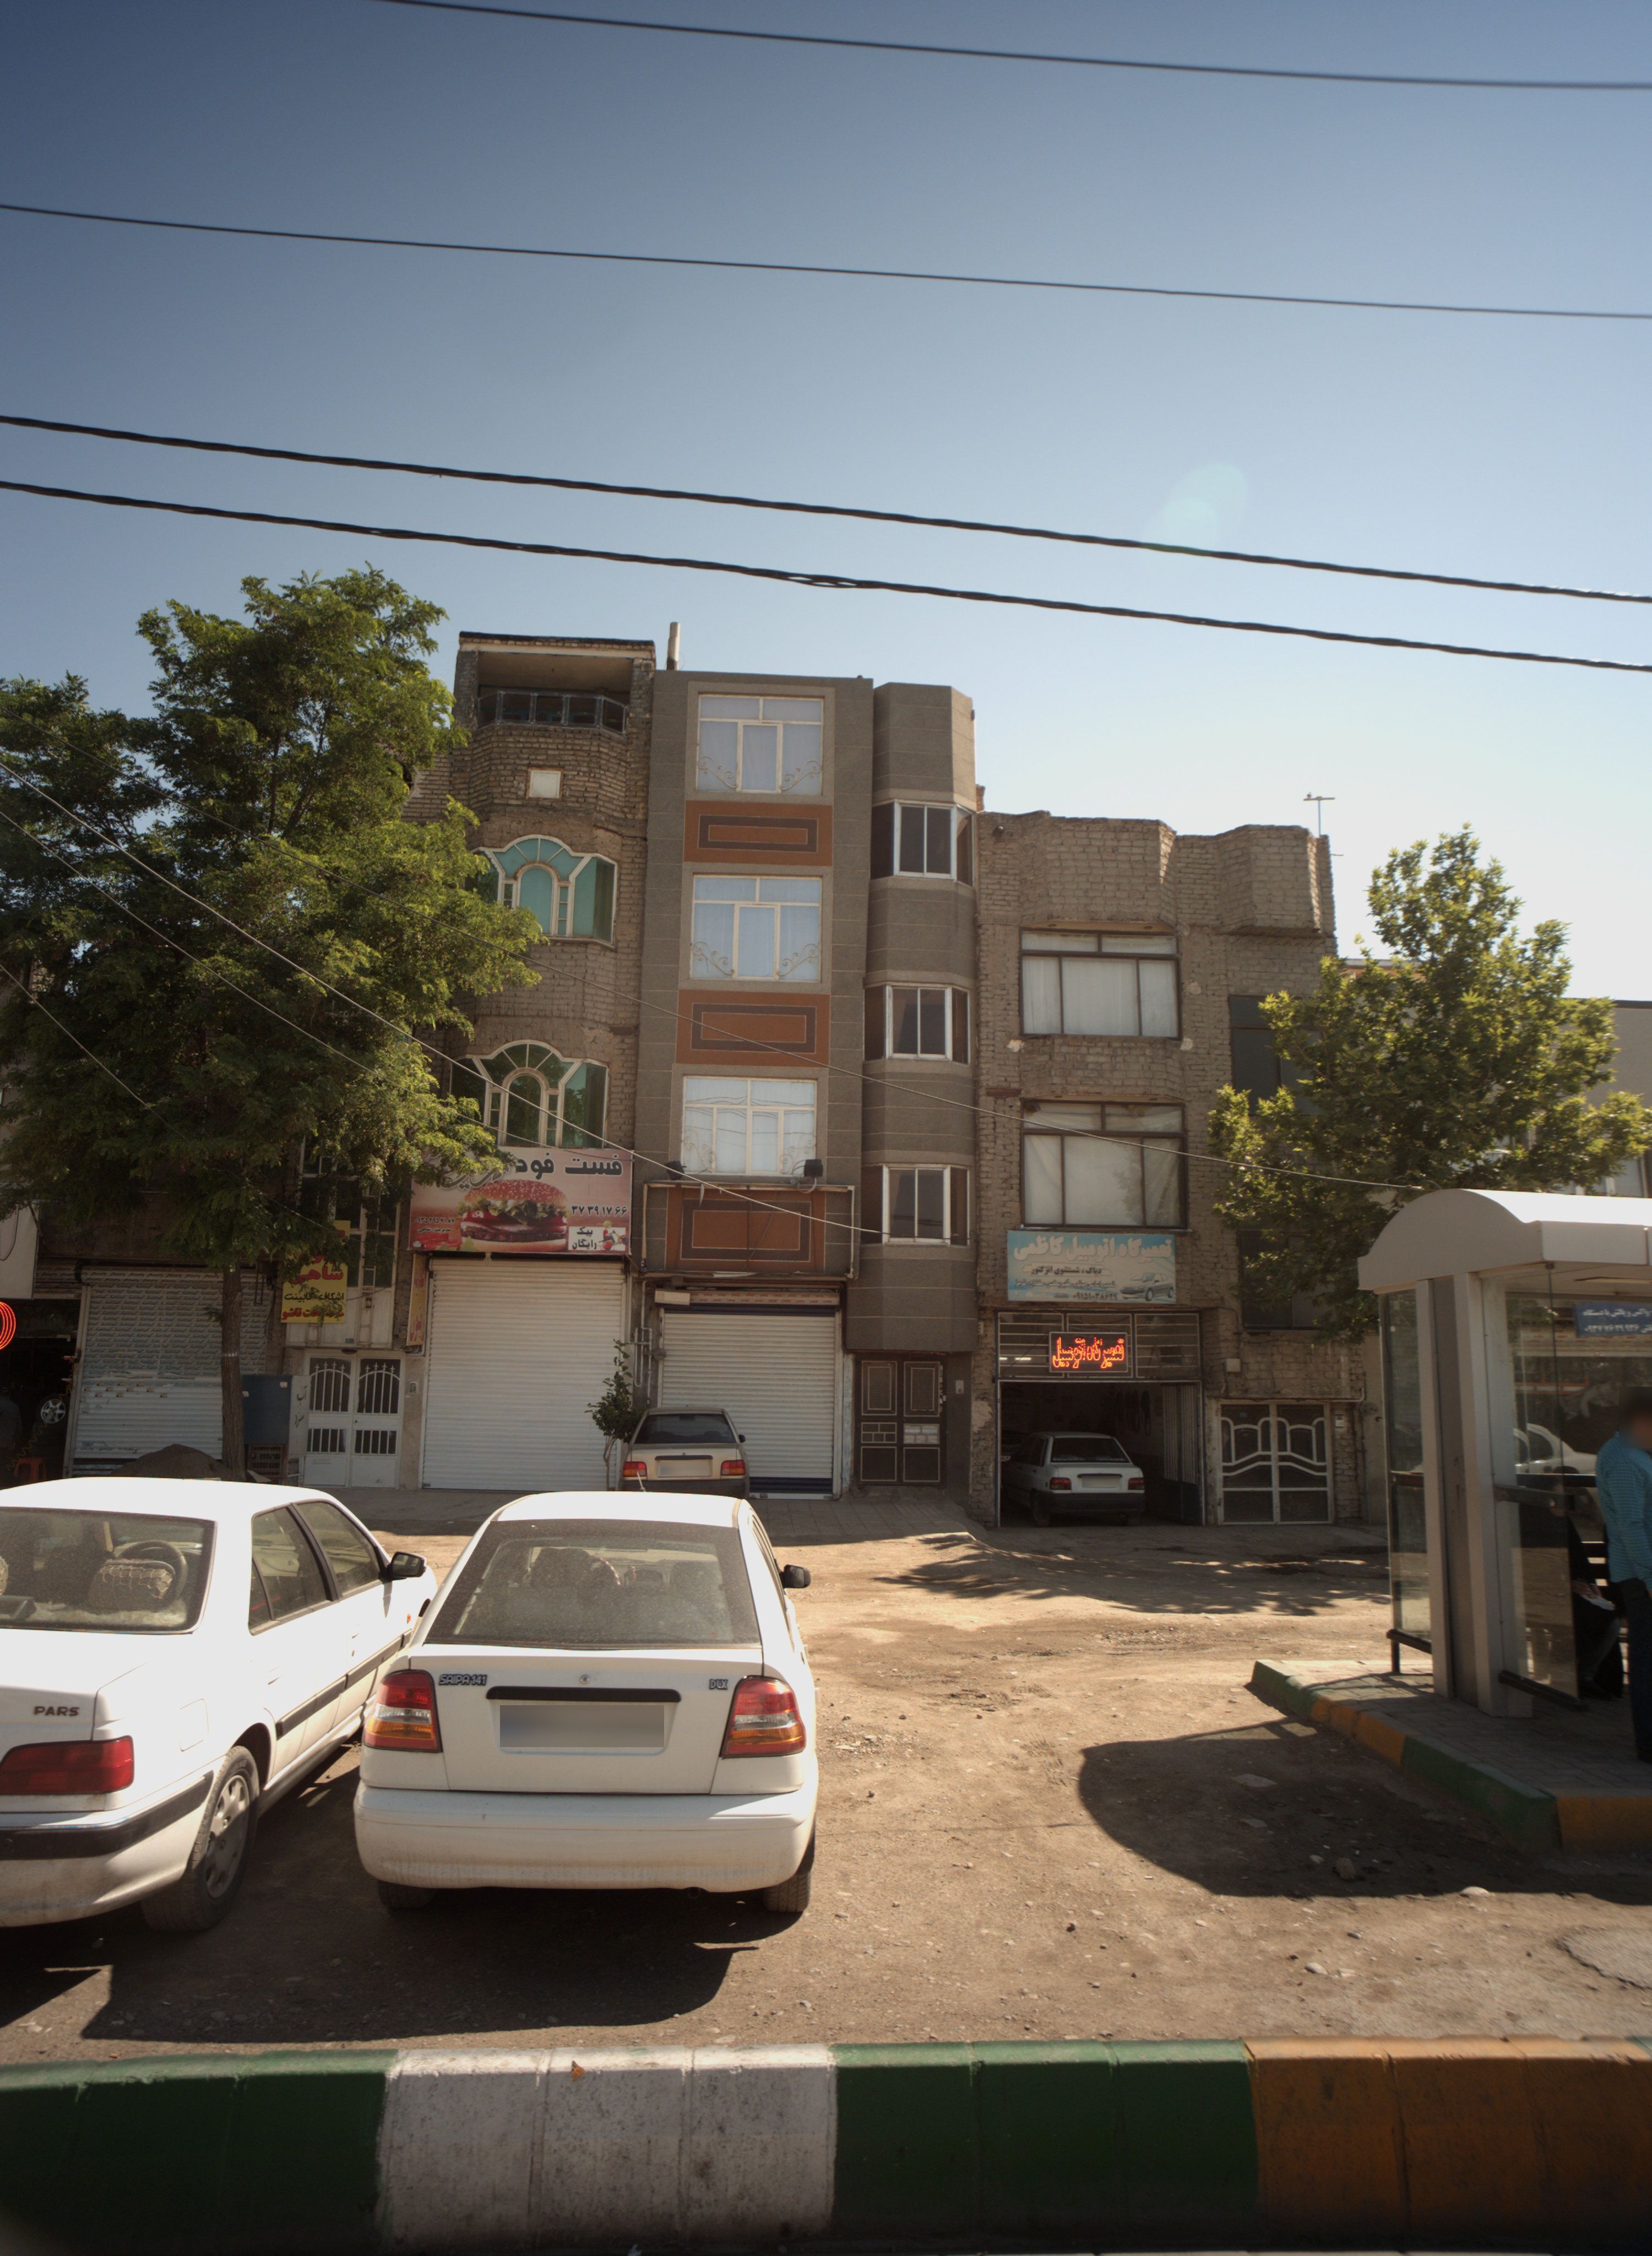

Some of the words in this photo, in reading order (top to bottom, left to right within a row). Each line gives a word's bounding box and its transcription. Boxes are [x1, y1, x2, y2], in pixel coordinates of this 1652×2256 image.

[515, 1152, 555, 1180] فود
[564, 1153, 623, 1176] فست
[577, 1227, 593, 1238] پیک
[572, 1238, 597, 1249] رایگان
[1014, 1235, 1064, 1261] کاظمی
[1066, 1235, 1115, 1262] اتومبیل
[439, 1674, 470, 1685] SAIPA
[470, 1674, 487, 1685] 141
[709, 1678, 728, 1690] DLX
[33, 1706, 80, 1717] PARS
